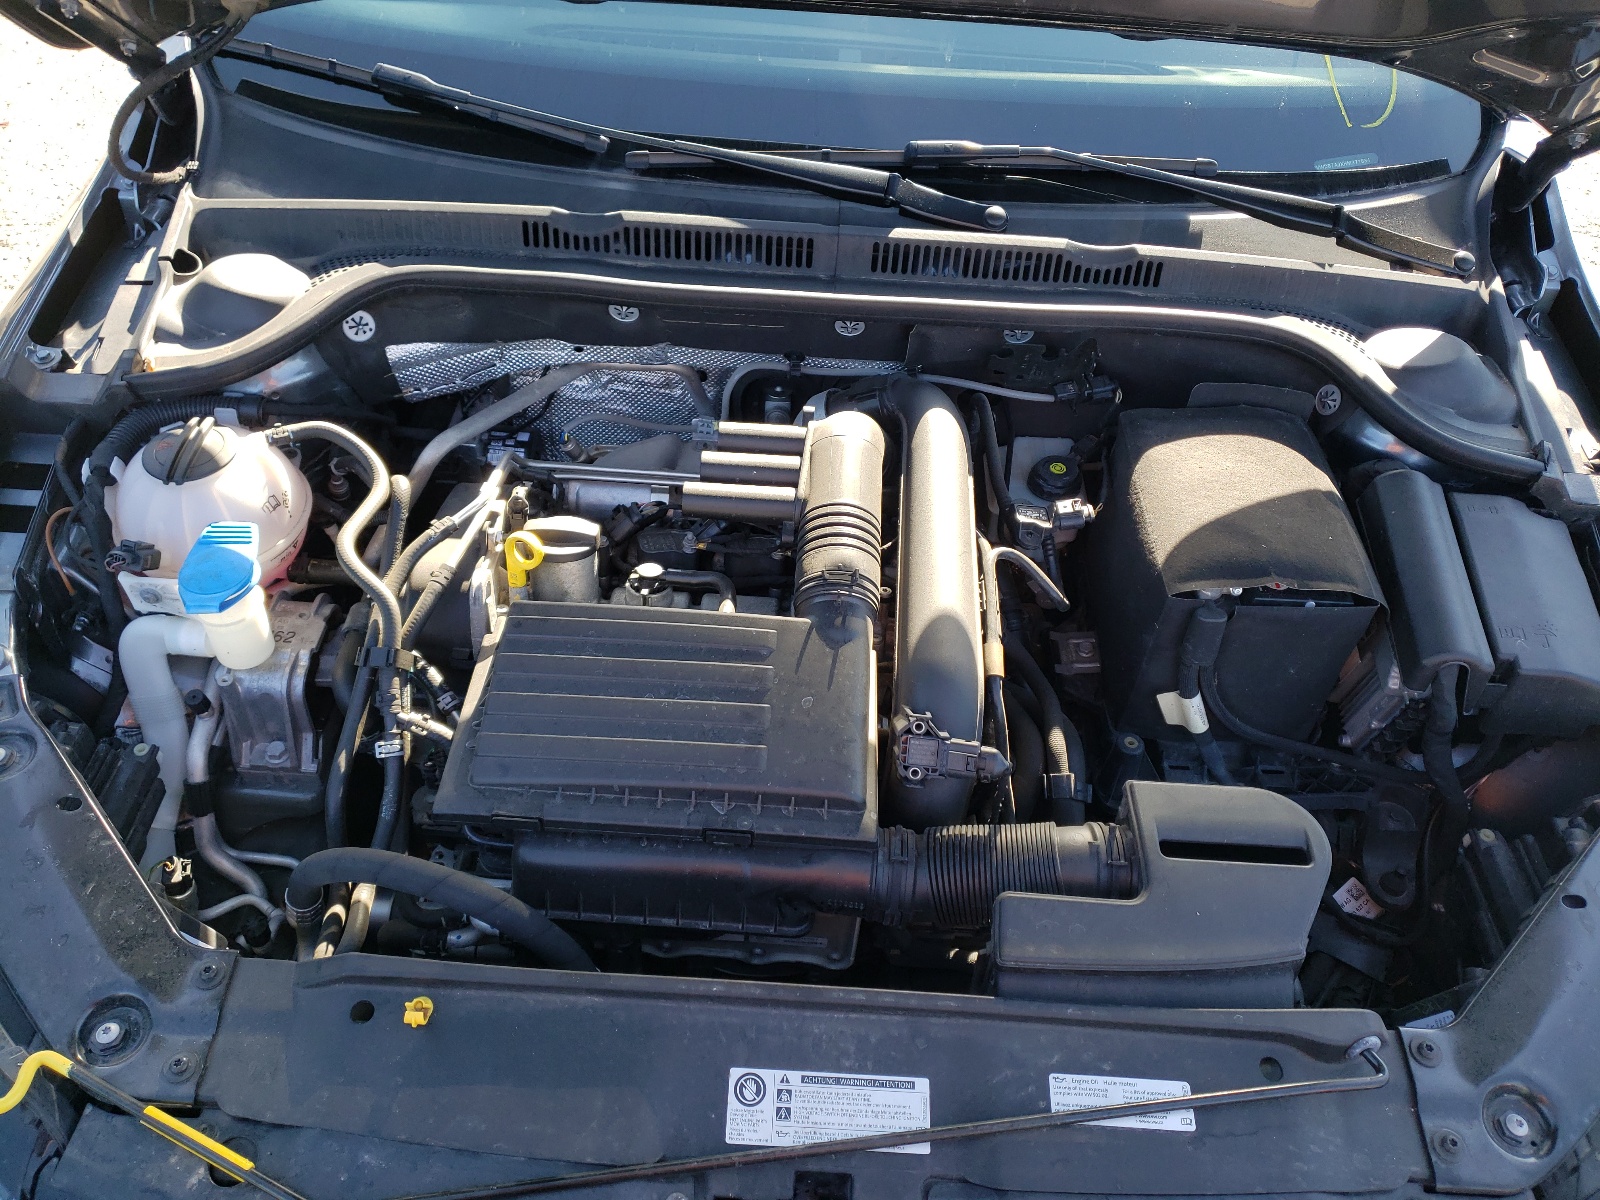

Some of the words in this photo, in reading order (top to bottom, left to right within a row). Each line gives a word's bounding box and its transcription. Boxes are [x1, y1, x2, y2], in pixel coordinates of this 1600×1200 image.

[803, 1076, 838, 1085] ACHTUNG!
[840, 1078, 874, 1087] WARNING!
[875, 1080, 913, 1089] ATTENTION!
